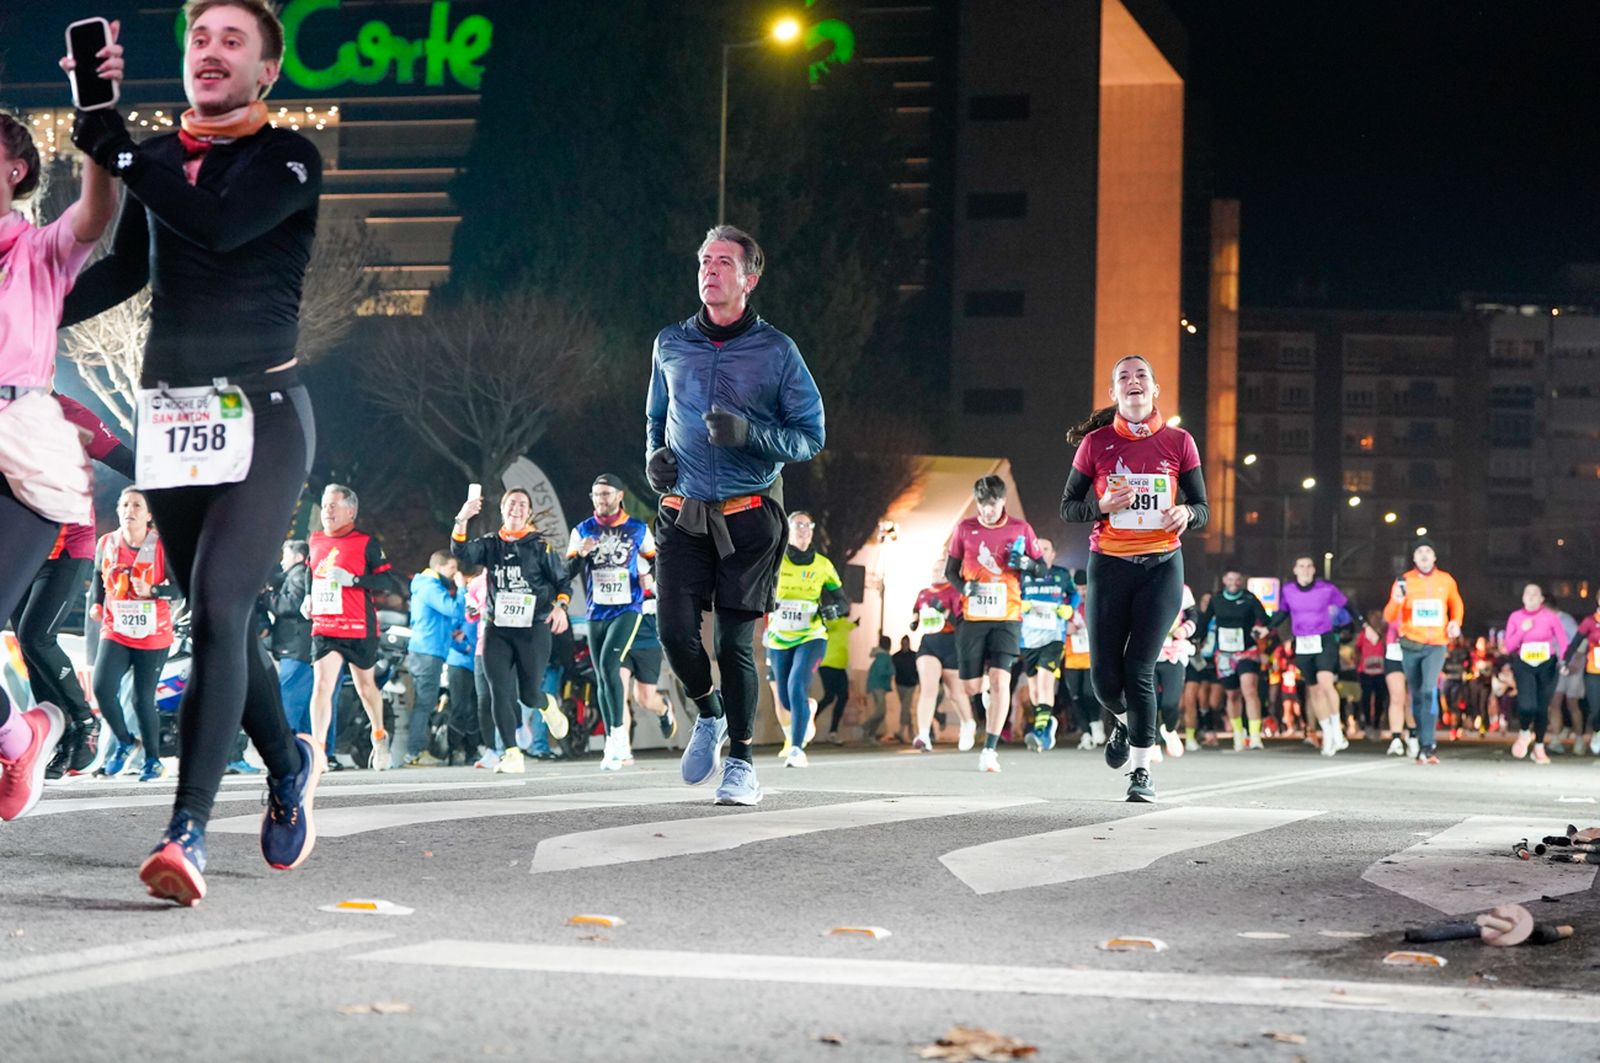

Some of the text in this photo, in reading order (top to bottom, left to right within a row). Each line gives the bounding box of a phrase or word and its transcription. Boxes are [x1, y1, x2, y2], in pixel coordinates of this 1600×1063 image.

[281, 0, 493, 90] Corte
[165, 397, 208, 410] NOCHE DE
[152, 413, 173, 424] SAN
[165, 424, 226, 453] 1758
[1126, 494, 1158, 510] 891
[600, 583, 622, 593] 2972
[976, 595, 997, 605] 3741
[503, 605, 525, 615] 2971
[121, 614, 147, 626] 3219
